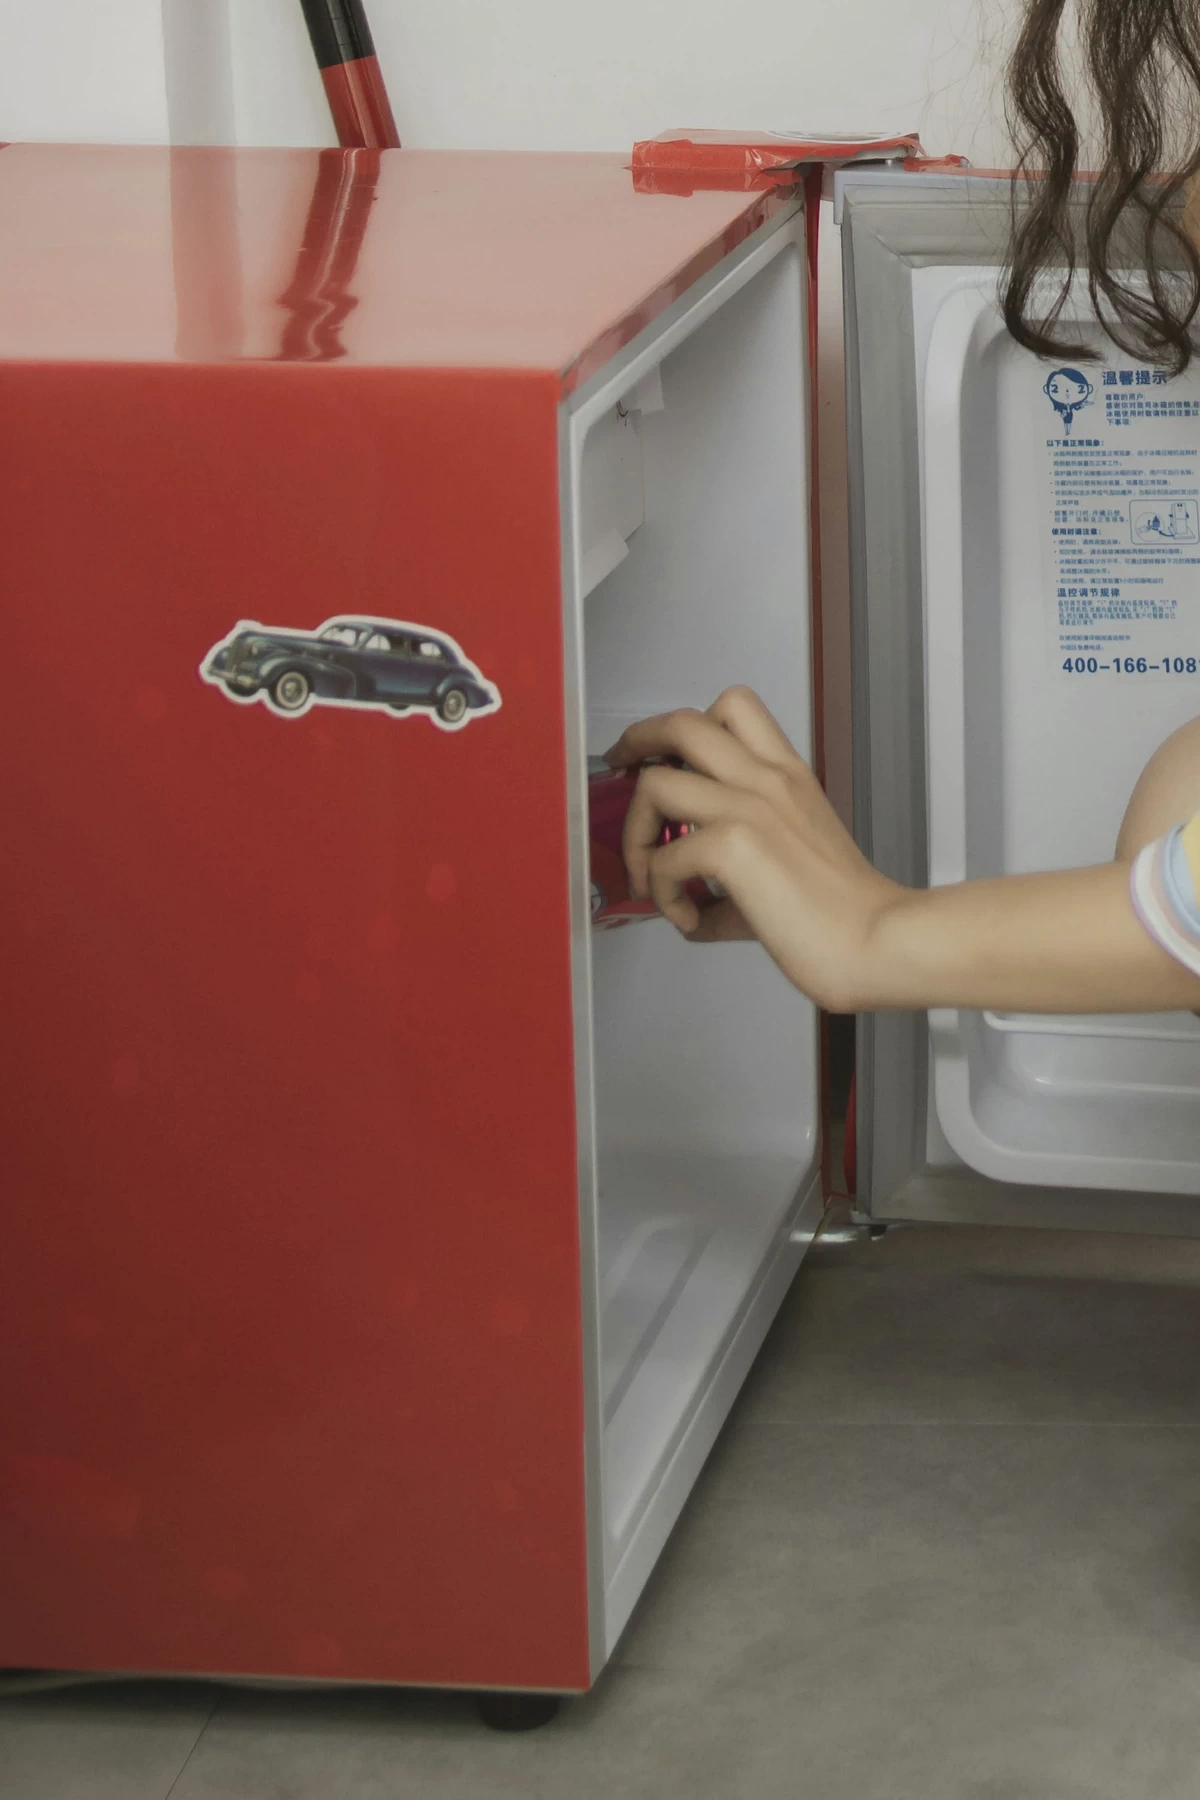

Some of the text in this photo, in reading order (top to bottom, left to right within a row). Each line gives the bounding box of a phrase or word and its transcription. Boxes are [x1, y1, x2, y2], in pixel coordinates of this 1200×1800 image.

[1102, 370, 1168, 386] 温馨提示
[1057, 587, 1120, 598] 温控调节规律
